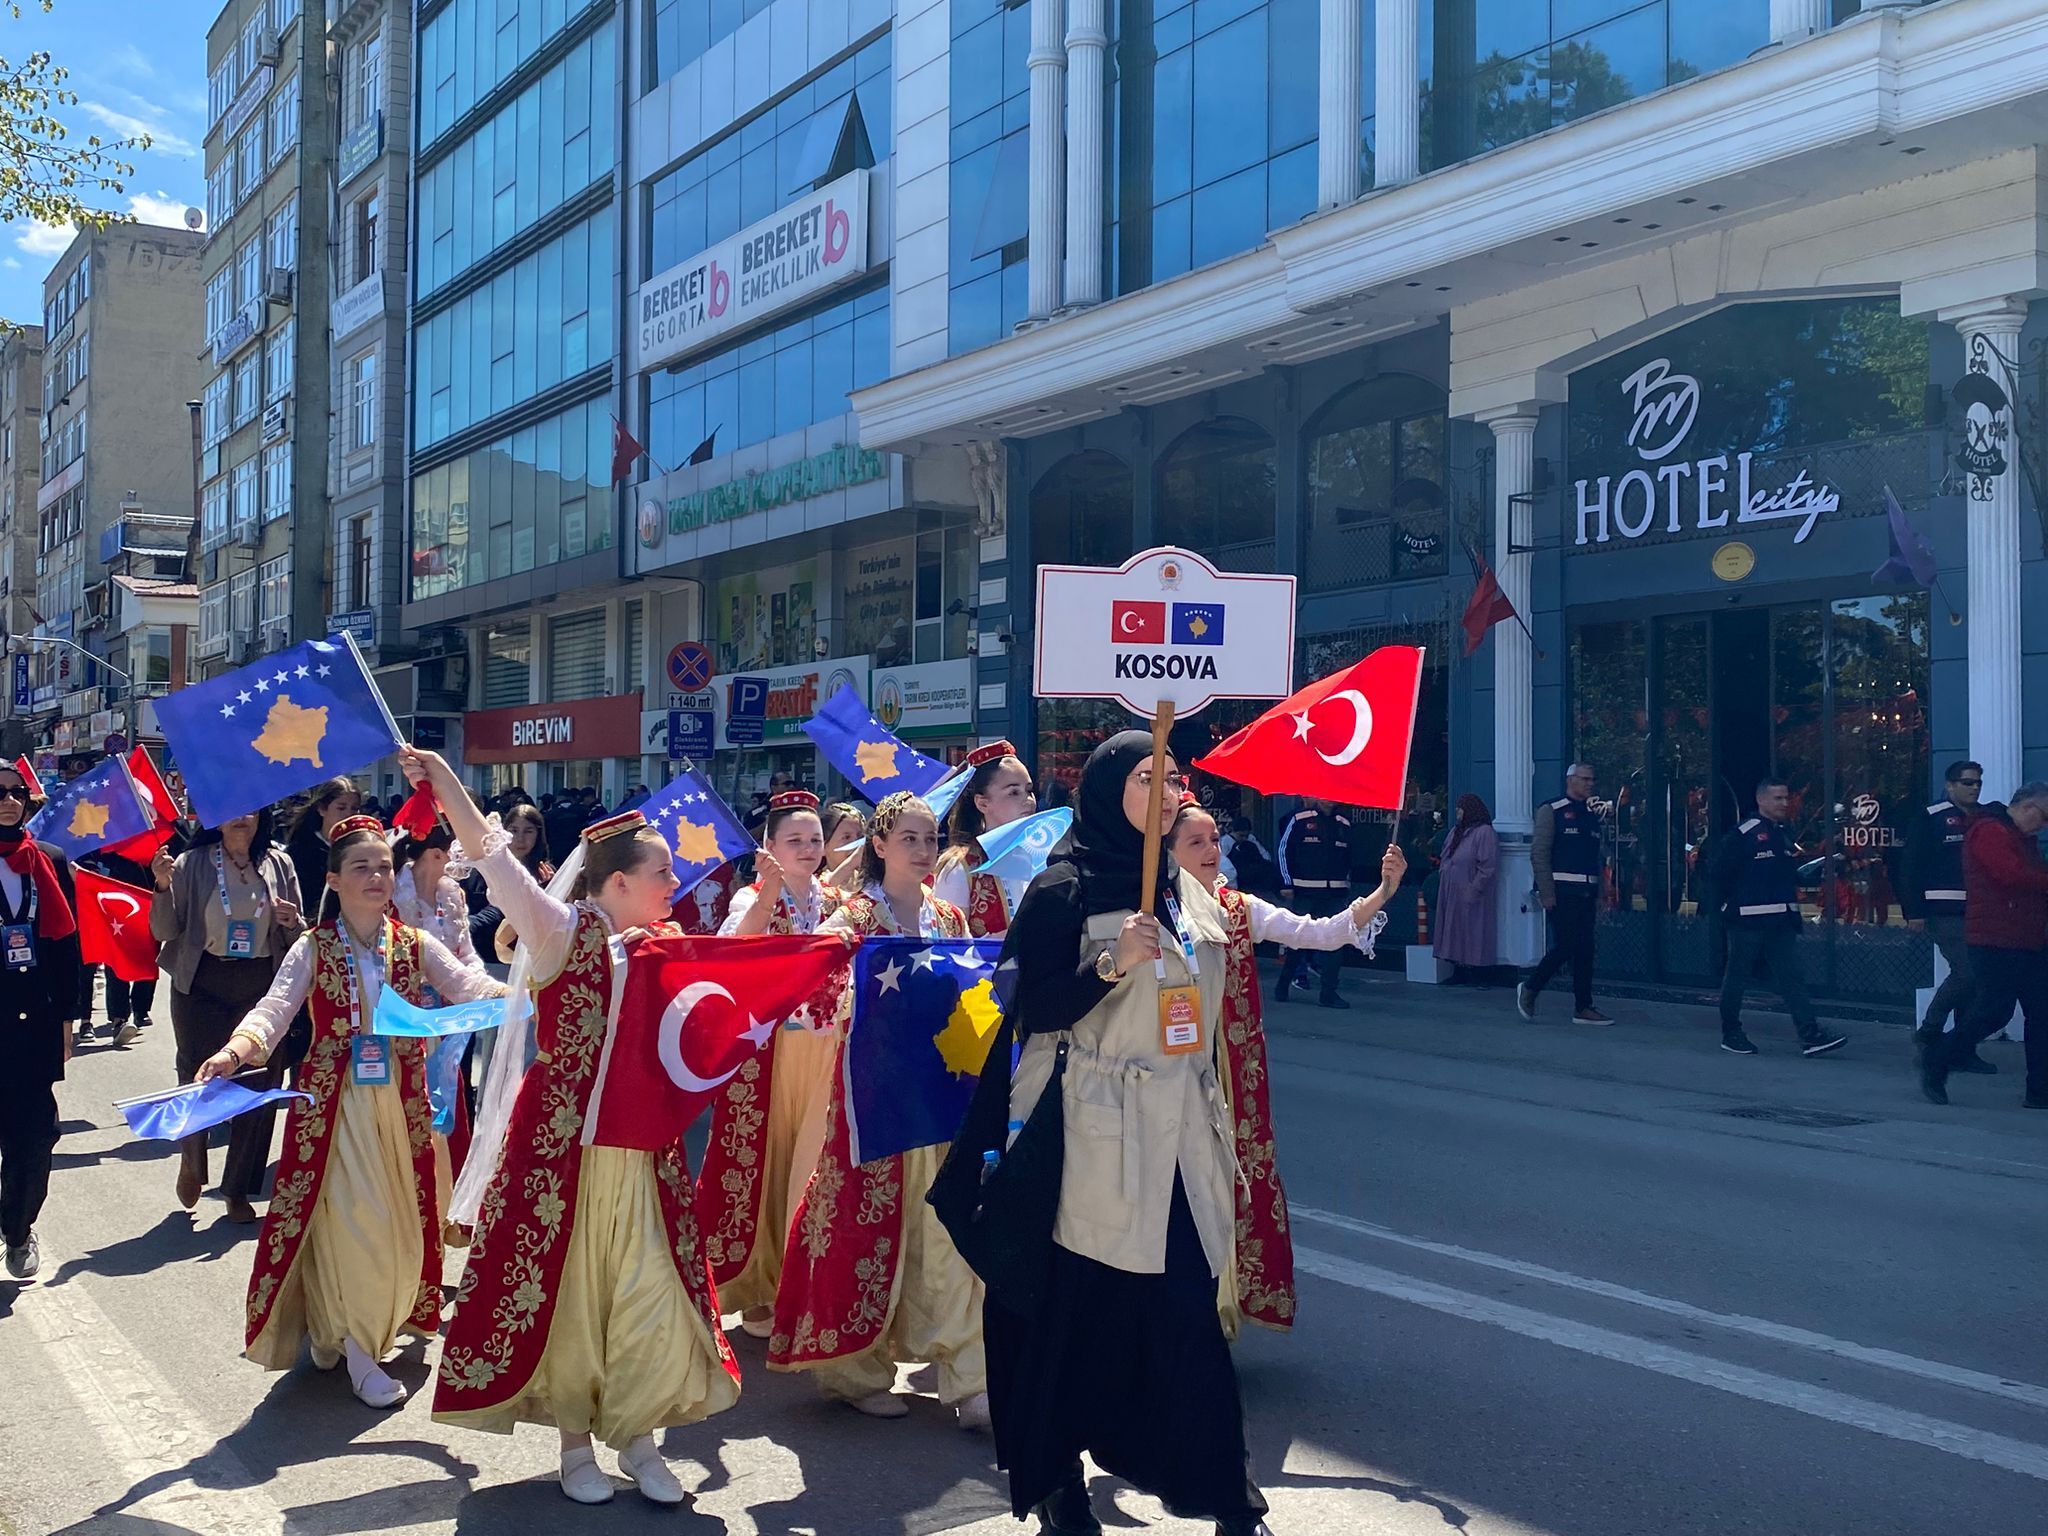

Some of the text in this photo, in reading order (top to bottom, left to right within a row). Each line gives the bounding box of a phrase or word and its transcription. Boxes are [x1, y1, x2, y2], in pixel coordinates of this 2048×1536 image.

[742, 204, 822, 274] BEREKET
[741, 244, 820, 307] EMEKLİLİK
[643, 265, 707, 324] BEREKET
[642, 303, 705, 351] SİGORTA
[1965, 447, 1999, 467] HOTEL
[1574, 452, 1840, 545] HOTEL city
[1403, 533, 1437, 550] HOTEL
[1115, 653, 1218, 681] KOSOVA
[679, 696, 696, 708] 140
[740, 684, 760, 713] P
[1350, 808, 1391, 825] HOTEL
[1843, 827, 1895, 848] HOTEL
